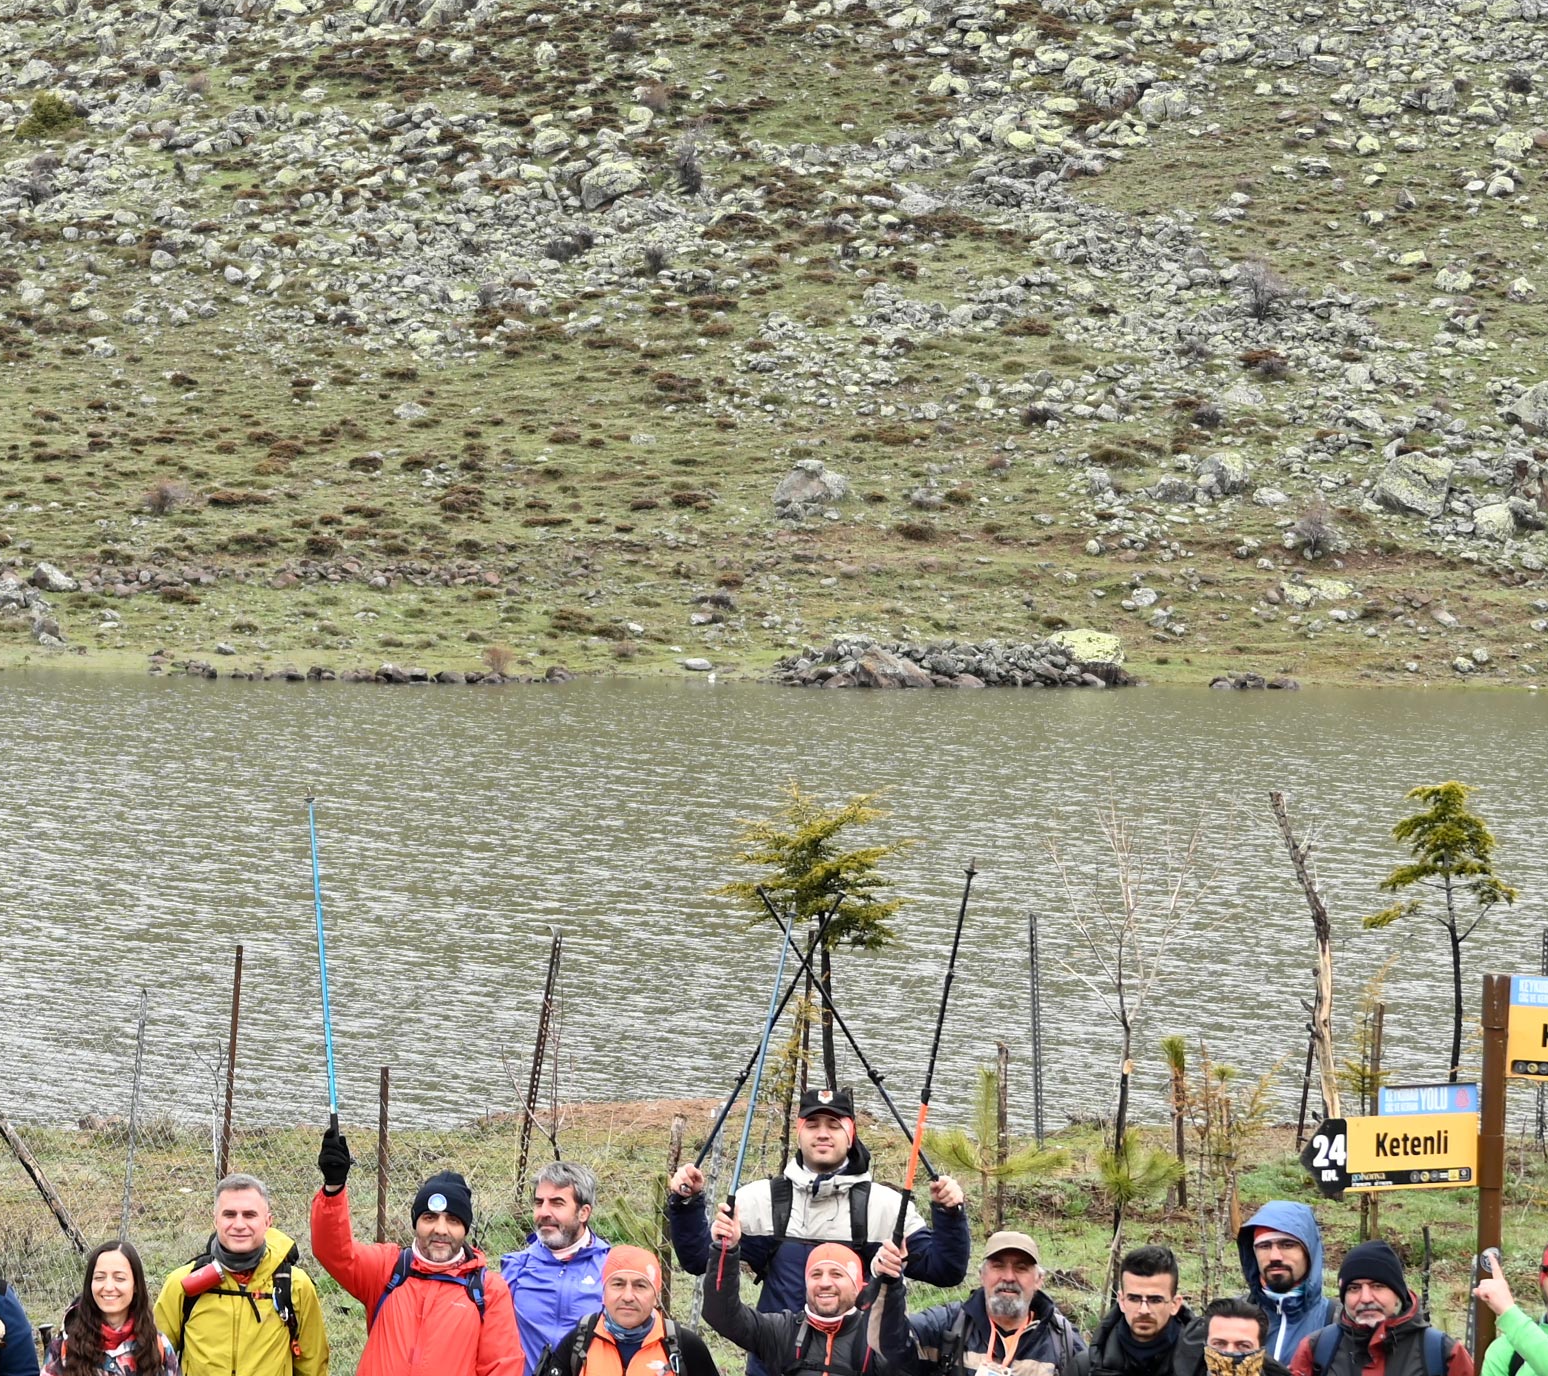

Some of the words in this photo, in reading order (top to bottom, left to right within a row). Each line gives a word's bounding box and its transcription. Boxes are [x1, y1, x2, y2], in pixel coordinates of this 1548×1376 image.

[1420, 1086, 1448, 1111] YOLU
[1312, 1133, 1347, 1167] 24
[1375, 1129, 1449, 1158] Ketenli
